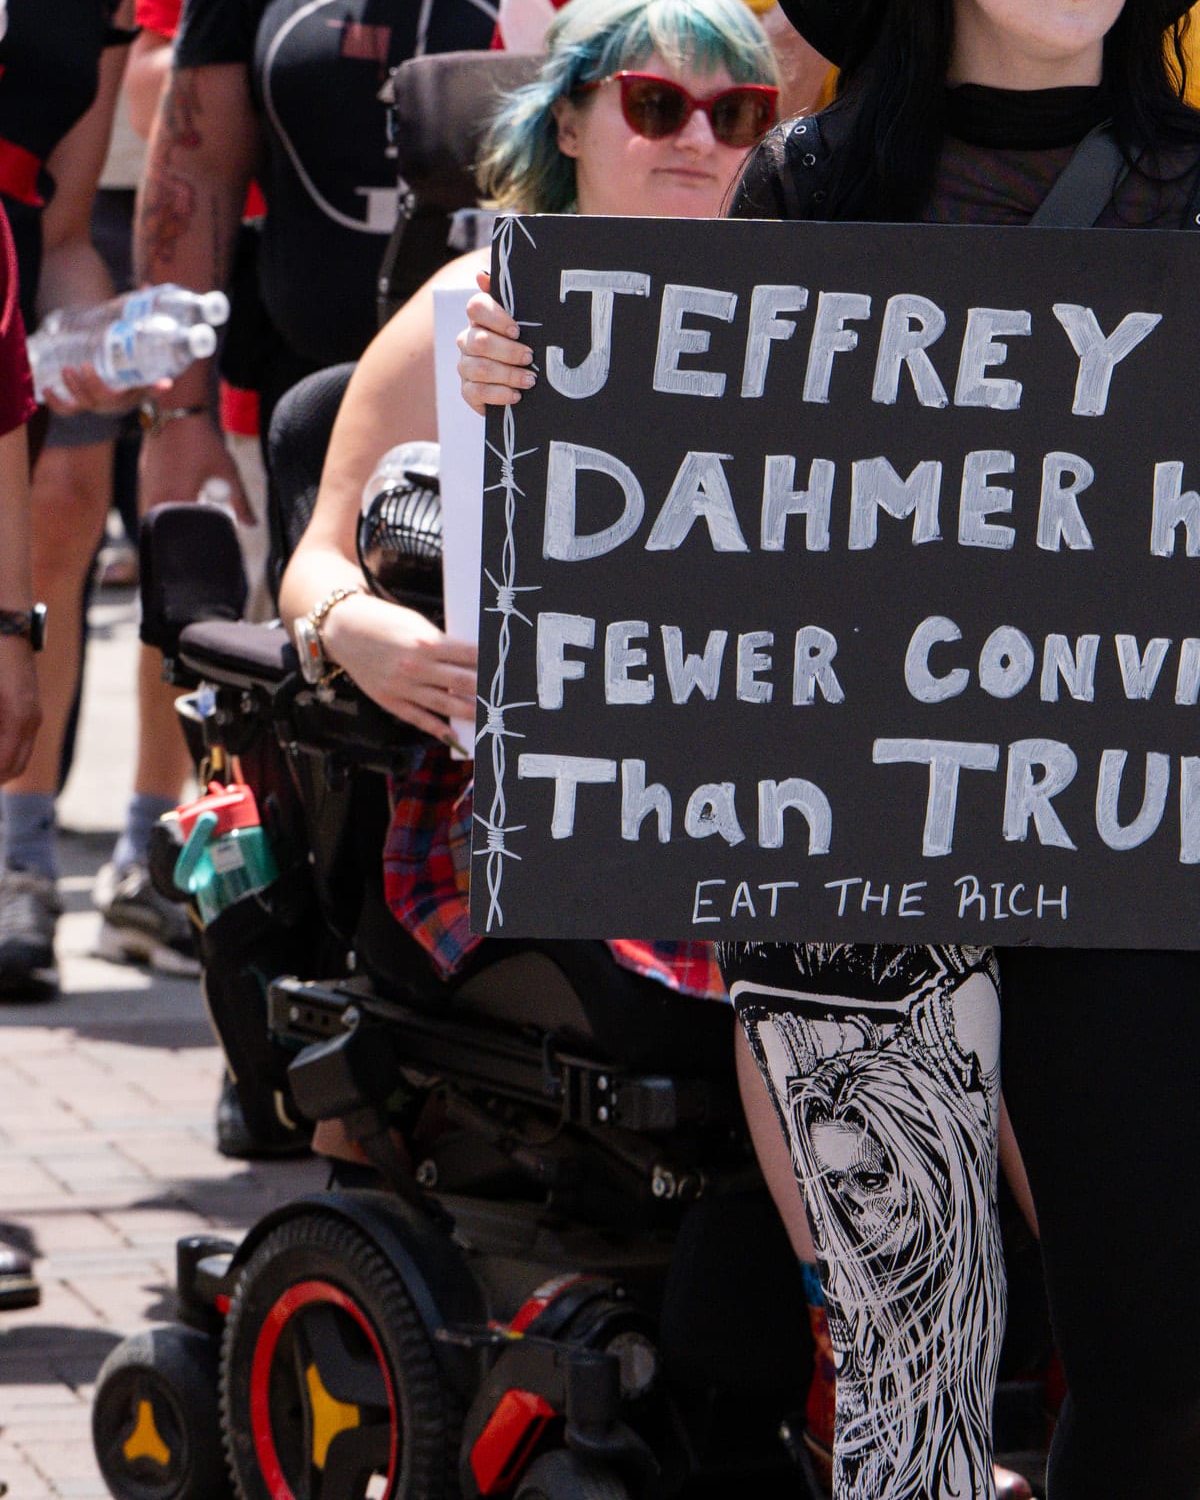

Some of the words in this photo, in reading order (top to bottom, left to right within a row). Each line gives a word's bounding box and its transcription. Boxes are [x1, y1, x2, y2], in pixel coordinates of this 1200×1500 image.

[544, 269, 1163, 417] JEFFREY
[541, 440, 1095, 562] DAHMER
[536, 611, 845, 710] FEWER
[517, 753, 832, 855] Than
[692, 879, 799, 925] EAT
[824, 877, 928, 918] THE
[954, 875, 1068, 922] RICH
